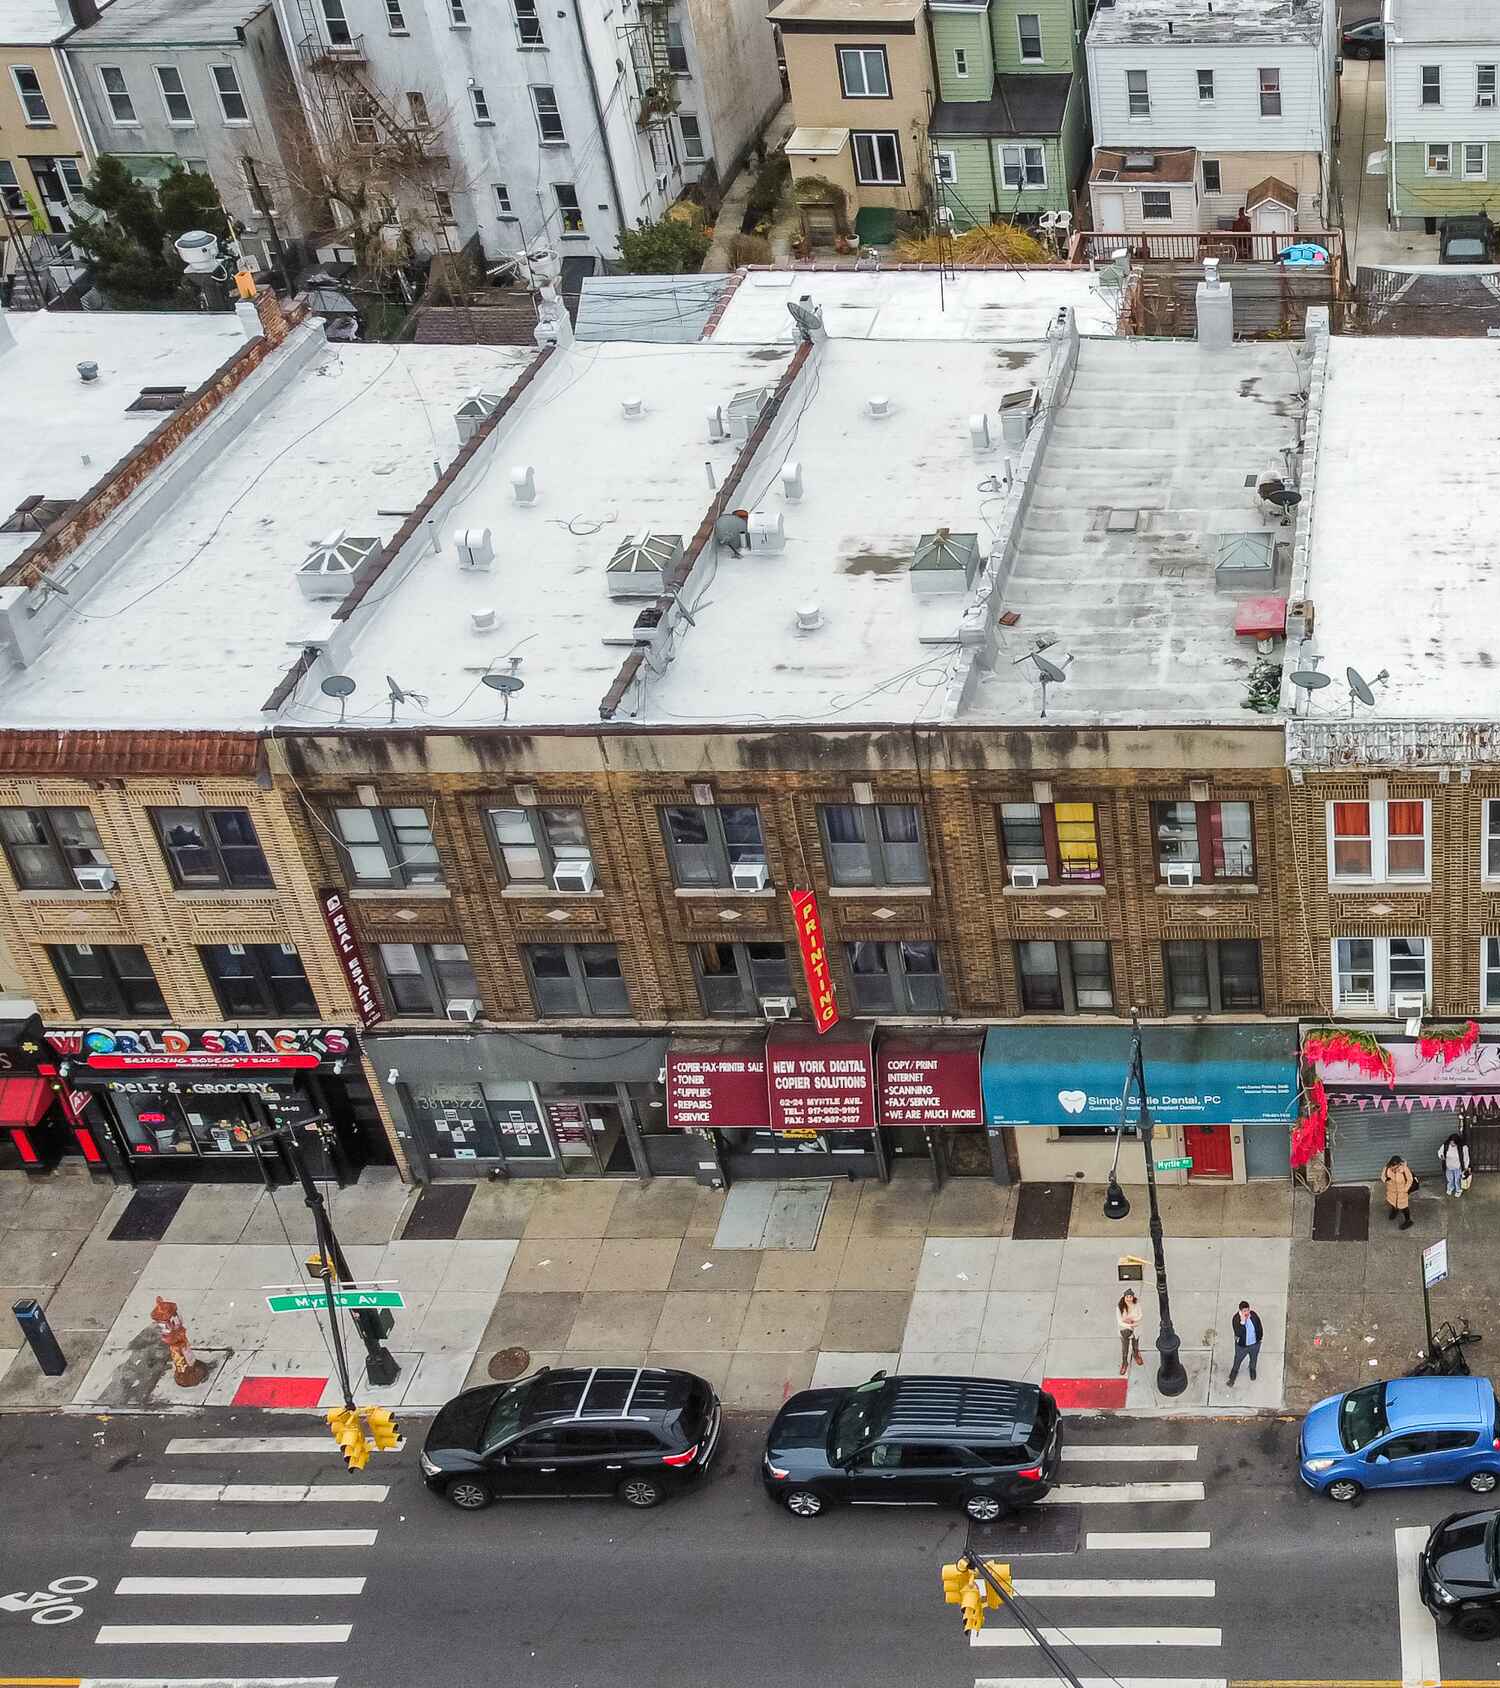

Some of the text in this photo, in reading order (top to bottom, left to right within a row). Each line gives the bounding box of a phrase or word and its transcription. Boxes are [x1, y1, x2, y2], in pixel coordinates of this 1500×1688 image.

[333, 914, 353, 952] REAL
[348, 957, 376, 1012] ESTATE
[803, 904, 834, 1020] PRINTING
[42, 1027, 350, 1054] WORLD SNACKS
[677, 1062, 764, 1072] COPIER-FAX-PRINTER SALE
[773, 1060, 867, 1073] NEW YORK DIGITAL
[677, 1075, 705, 1084] TONER
[775, 1076, 867, 1089] COPIER SOLUTIONS
[887, 1073, 924, 1082] INTERNET
[168, 1081, 181, 1094] &
[677, 1088, 712, 1097] SUPPLIES
[889, 1086, 933, 1095] SCANNING
[677, 1101, 713, 1110] REPAIRS
[807, 1097, 841, 1106] MYRTLE
[889, 1097, 941, 1107] FAX/SERVICE
[1088, 1096, 1123, 1108] Simply
[1204, 1095, 1222, 1104] PC
[678, 1112, 710, 1121] SERVICE
[889, 1109, 976, 1119] WE ARE MUCH MORE
[295, 1295, 377, 1308] Myrle Av
